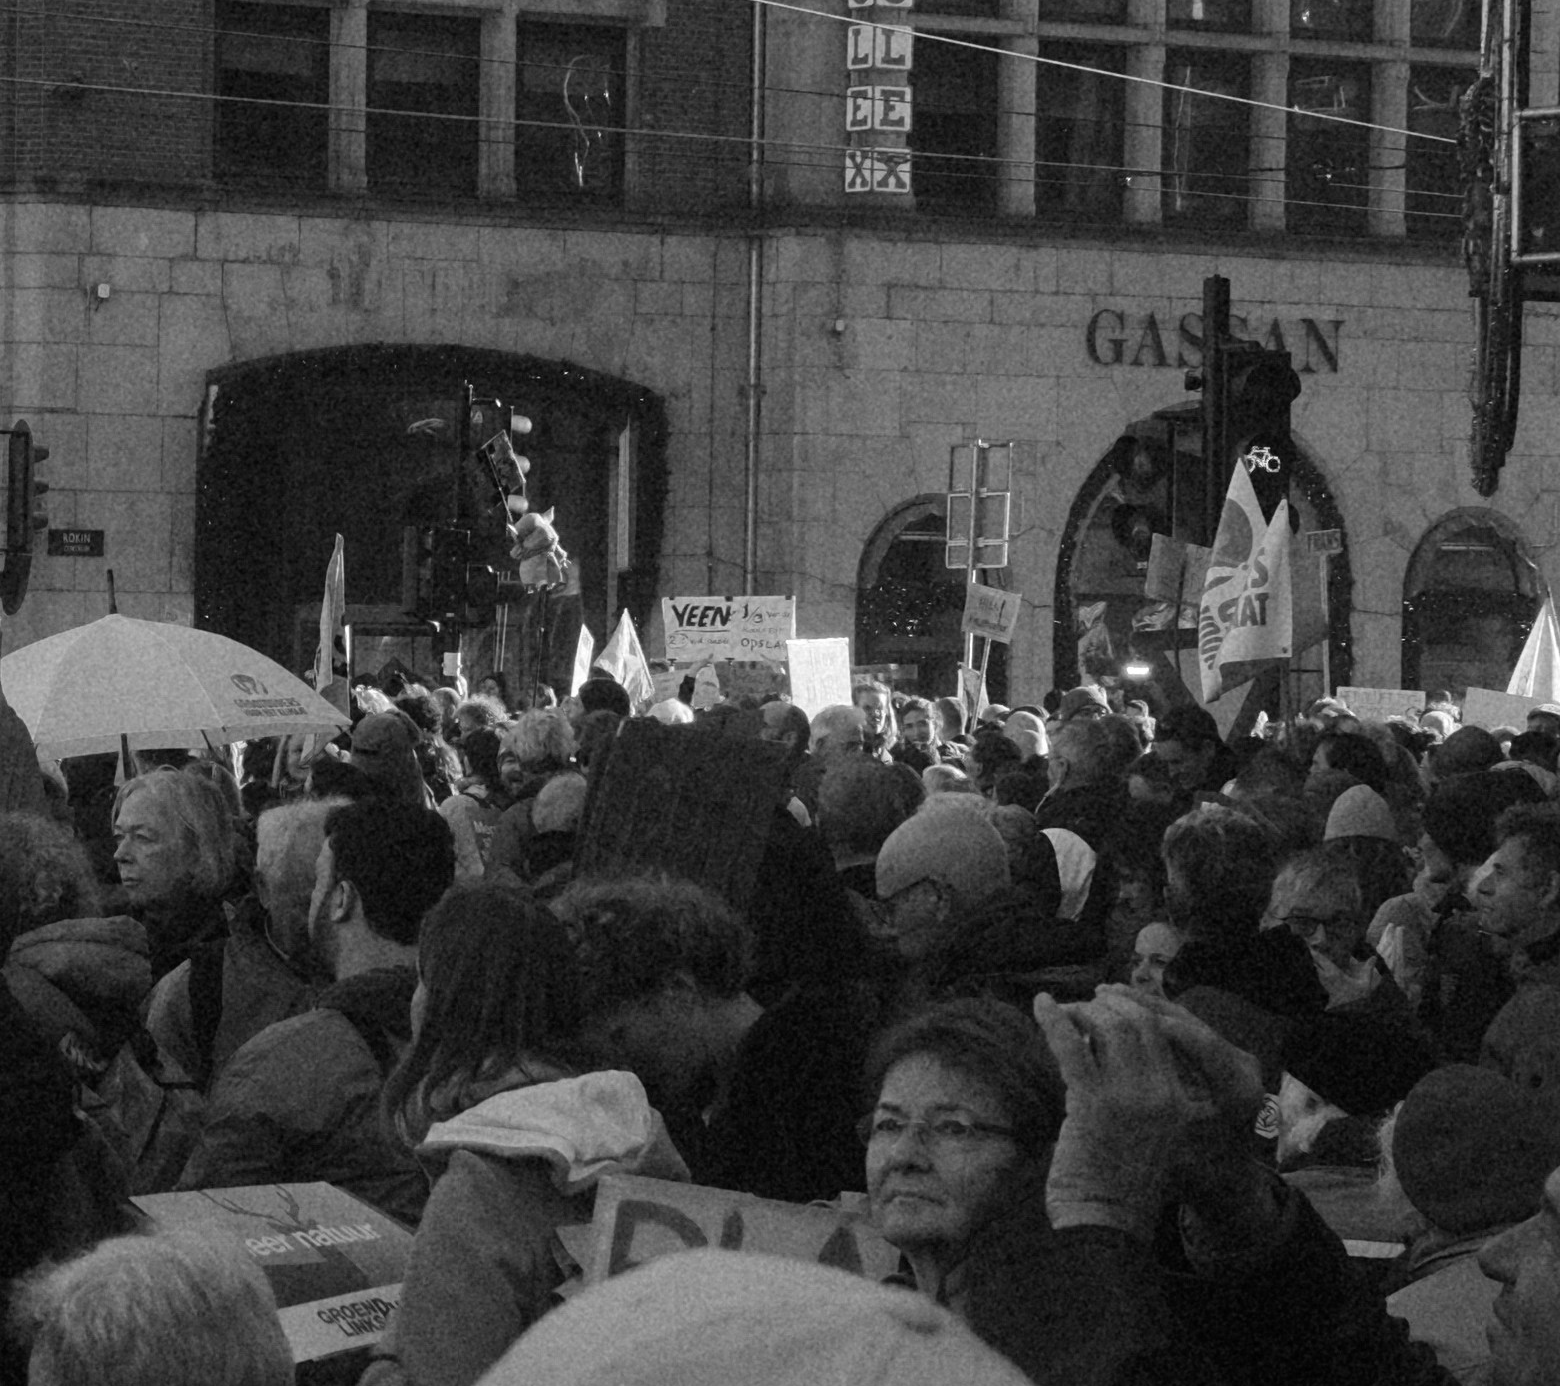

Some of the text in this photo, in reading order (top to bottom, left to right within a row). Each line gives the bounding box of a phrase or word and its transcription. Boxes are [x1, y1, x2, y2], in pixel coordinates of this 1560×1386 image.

[62, 532, 91, 543] ROKIN
[245, 1222, 382, 1257] eer natuur
[316, 1298, 380, 1324] GROEN
[338, 1315, 386, 1337] LINKS
